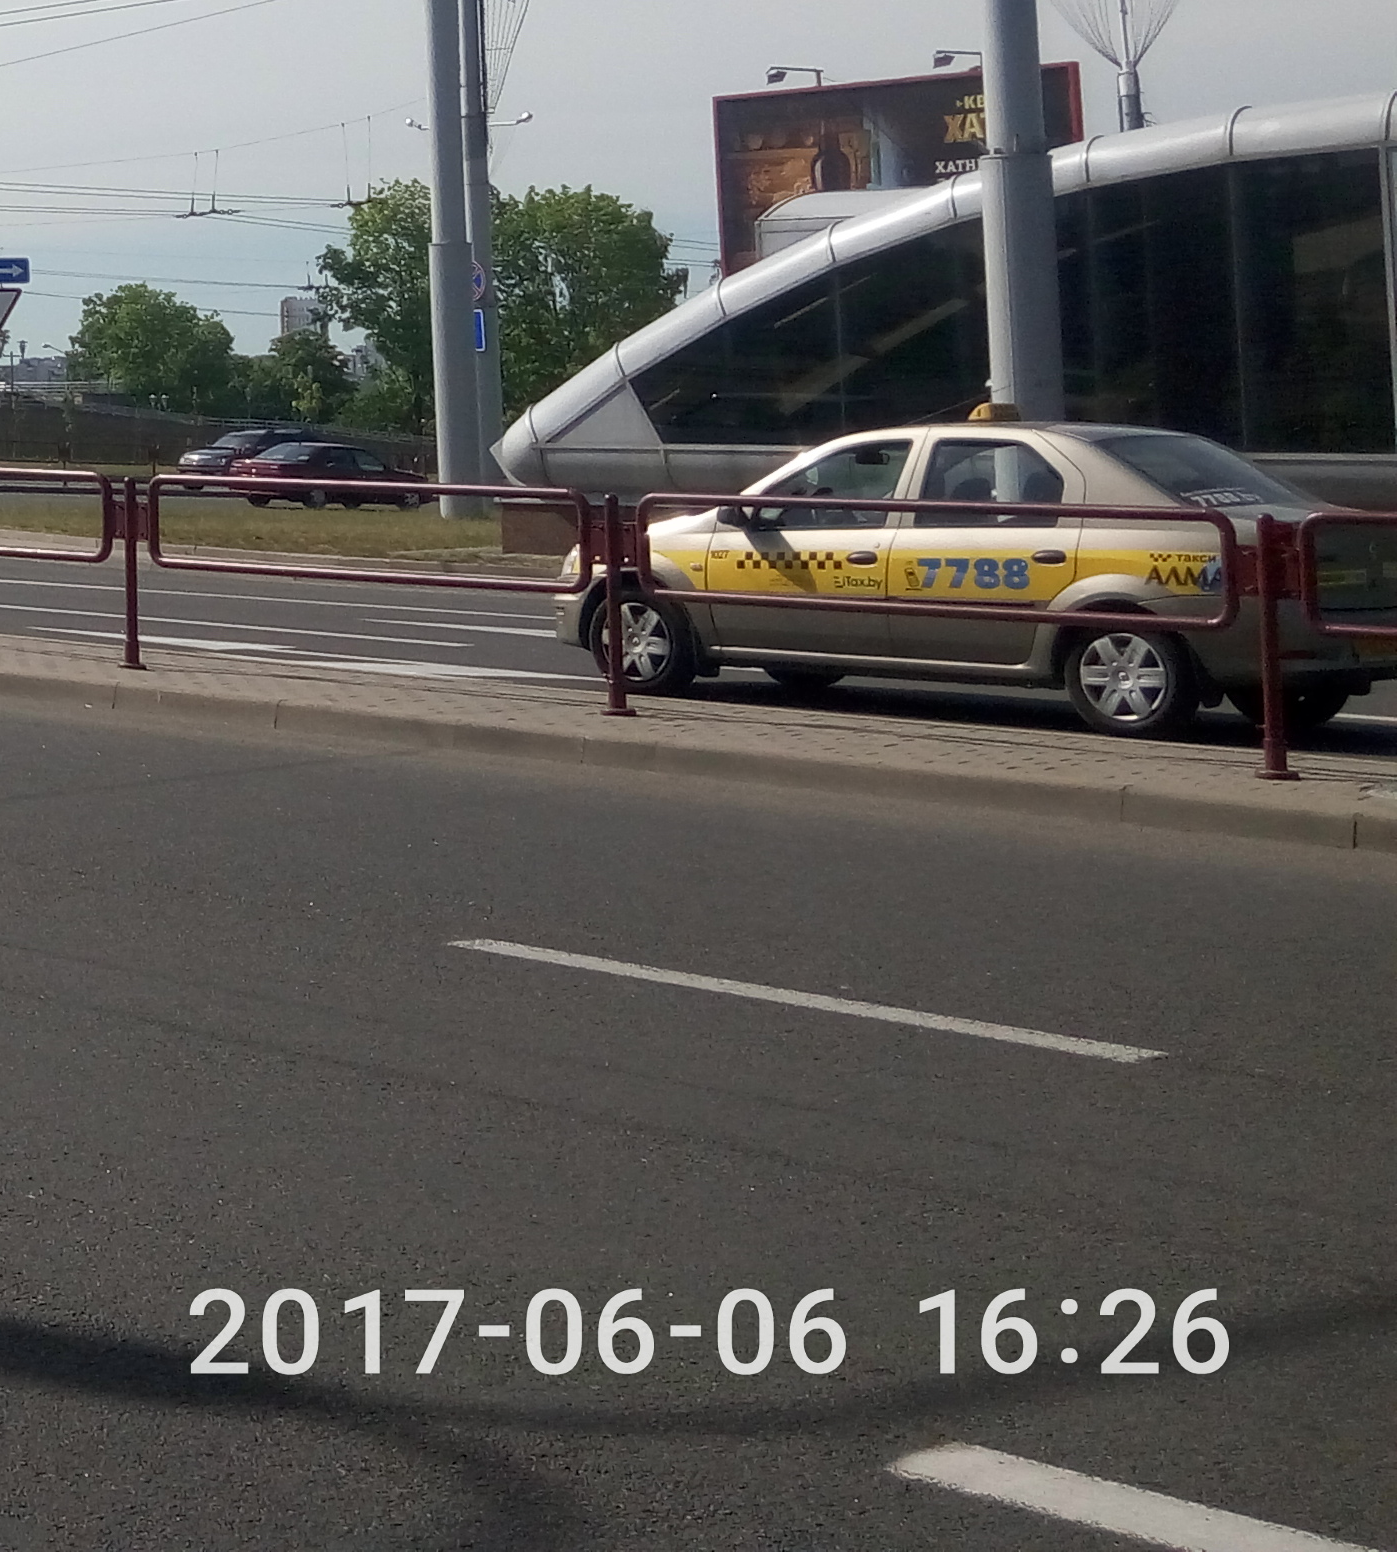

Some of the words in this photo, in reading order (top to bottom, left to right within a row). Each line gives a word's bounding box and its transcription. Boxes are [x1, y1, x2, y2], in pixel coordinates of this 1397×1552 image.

[964, 95, 985, 109] КВ
[943, 113, 985, 143] ХА
[935, 159, 978, 173] ХАТН
[916, 557, 1030, 590] 7788
[1144, 564, 1222, 586] АЛМА
